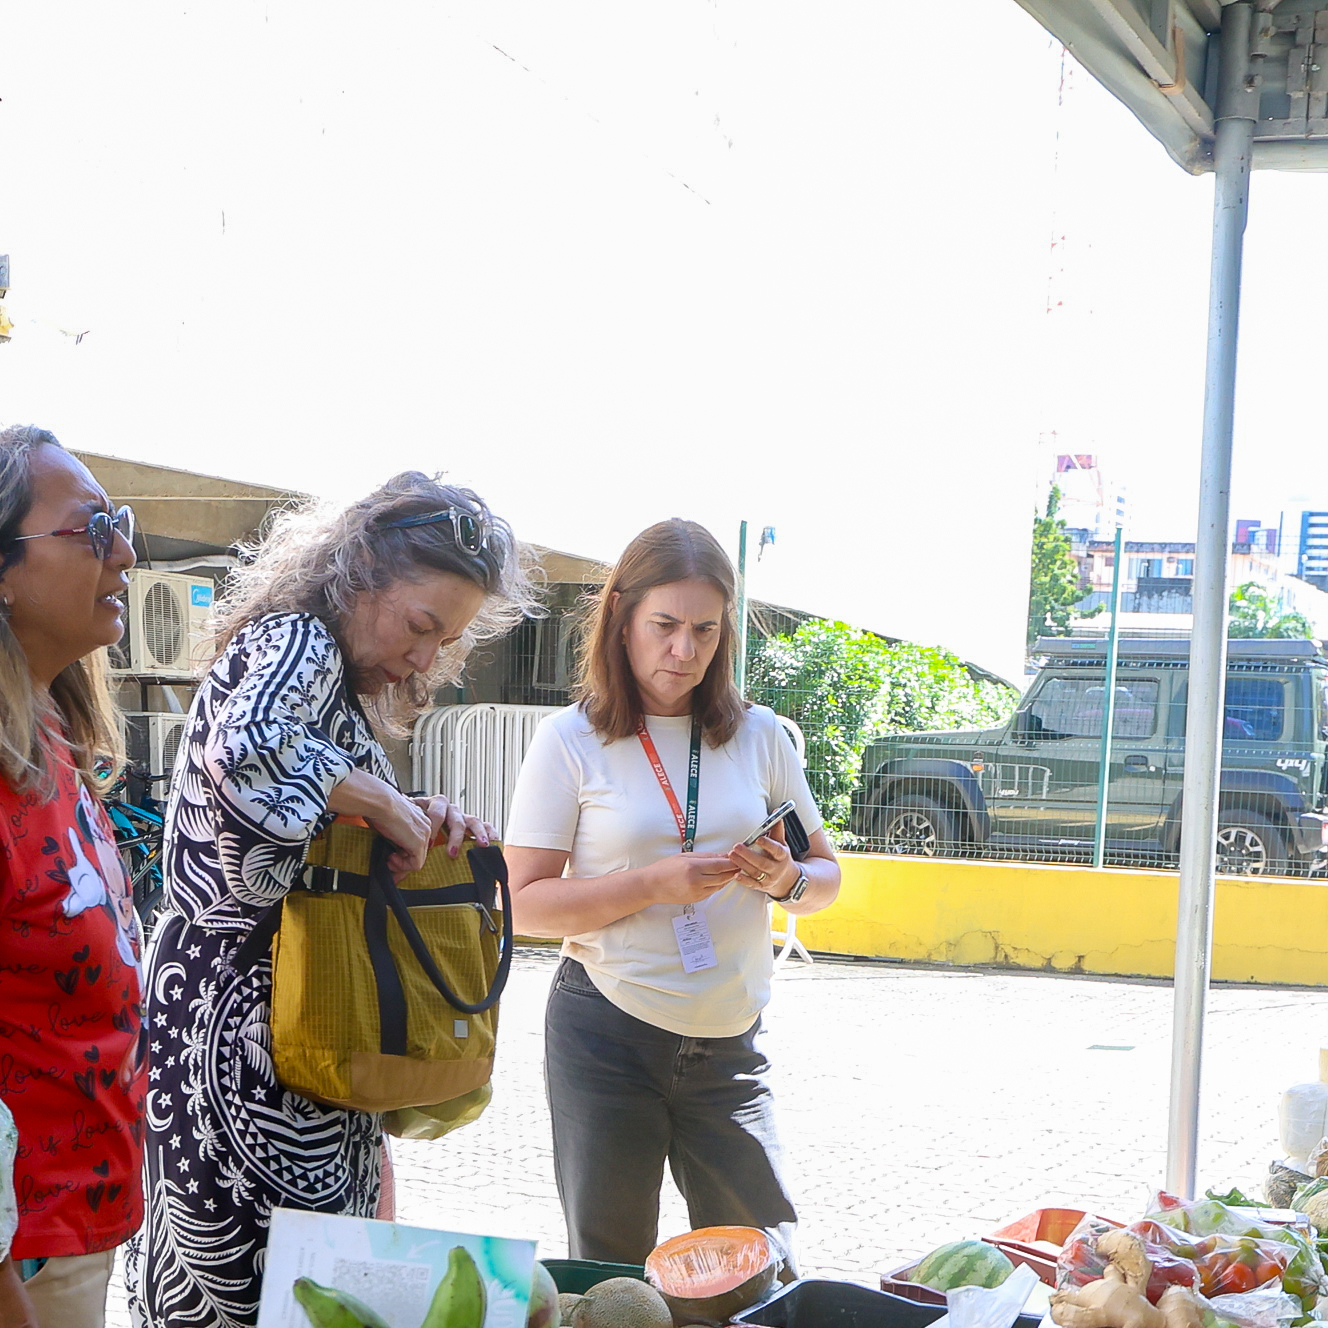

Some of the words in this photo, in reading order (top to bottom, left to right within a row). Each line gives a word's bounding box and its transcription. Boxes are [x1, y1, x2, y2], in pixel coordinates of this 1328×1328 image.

[654, 763, 670, 786] ALECE
[690, 754, 699, 778] ALECE
[687, 804, 696, 830] ALECE
[71, 1109, 123, 1151] Love
[18, 1174, 81, 1216] Love
